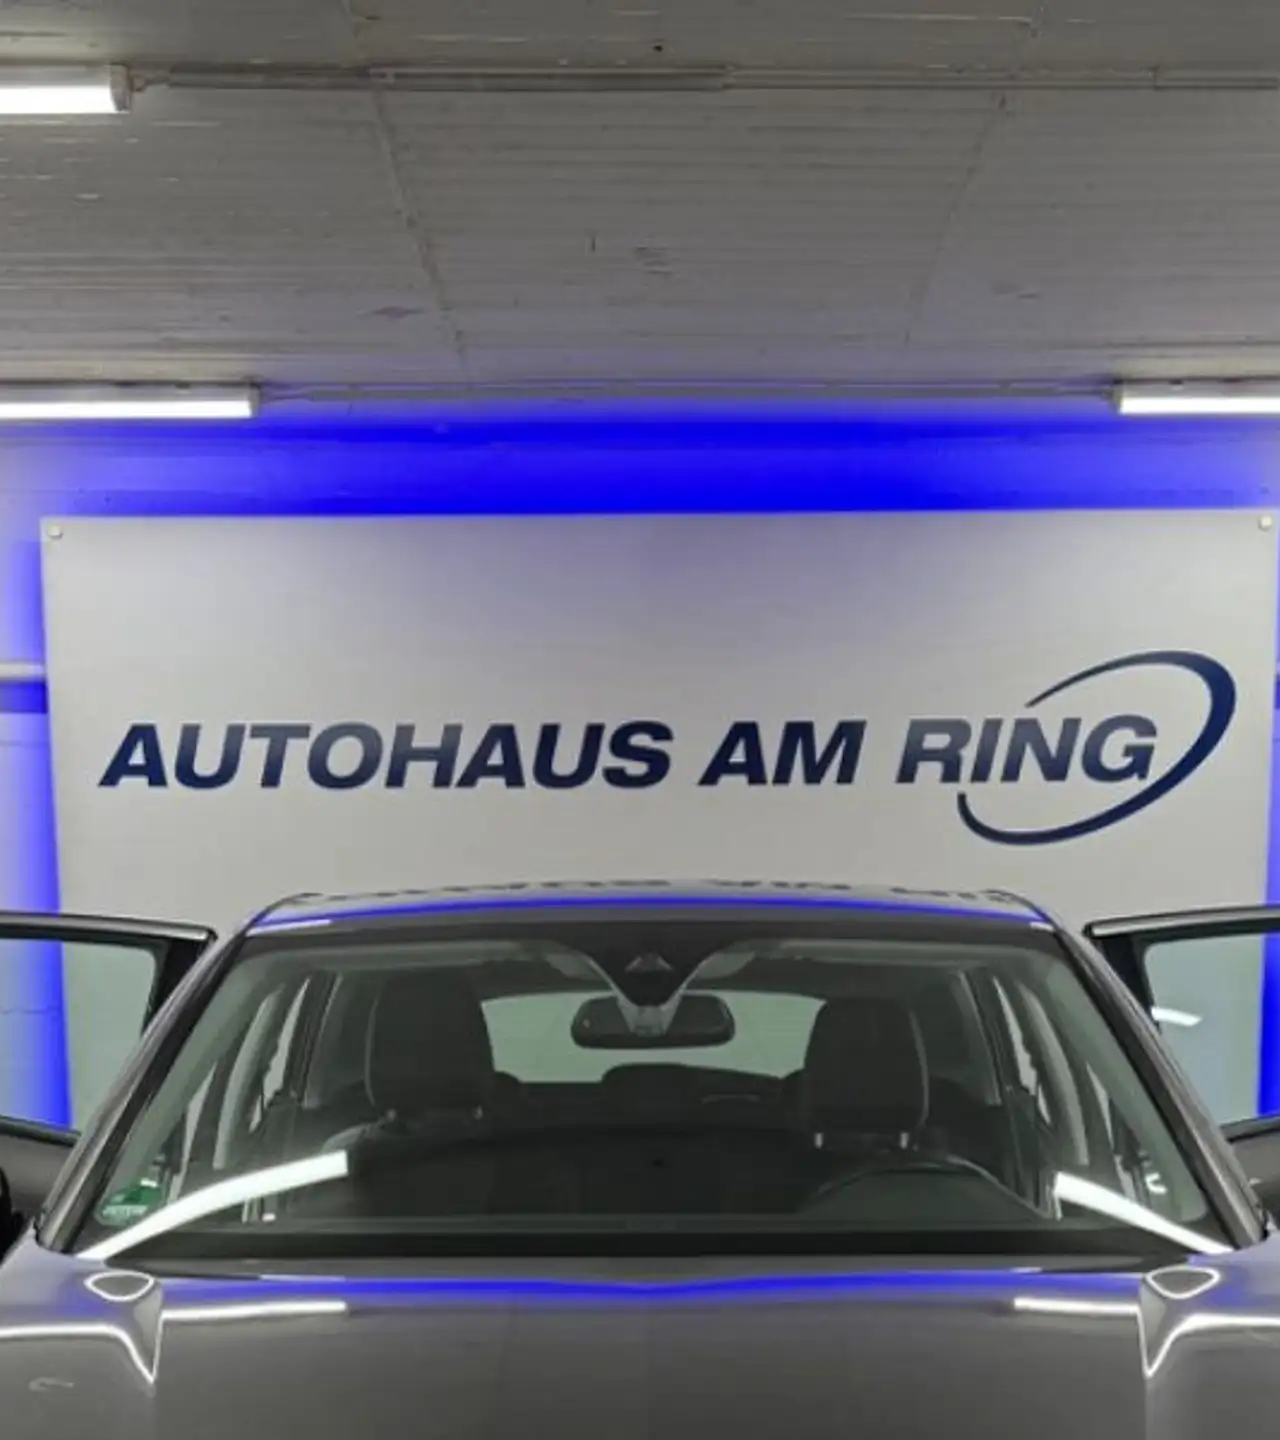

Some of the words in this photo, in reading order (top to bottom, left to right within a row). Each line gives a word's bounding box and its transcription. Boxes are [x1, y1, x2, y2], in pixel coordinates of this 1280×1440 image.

[98, 720, 675, 790] AUTOHAUS
[696, 718, 867, 787] AM
[895, 714, 1158, 785] RING
